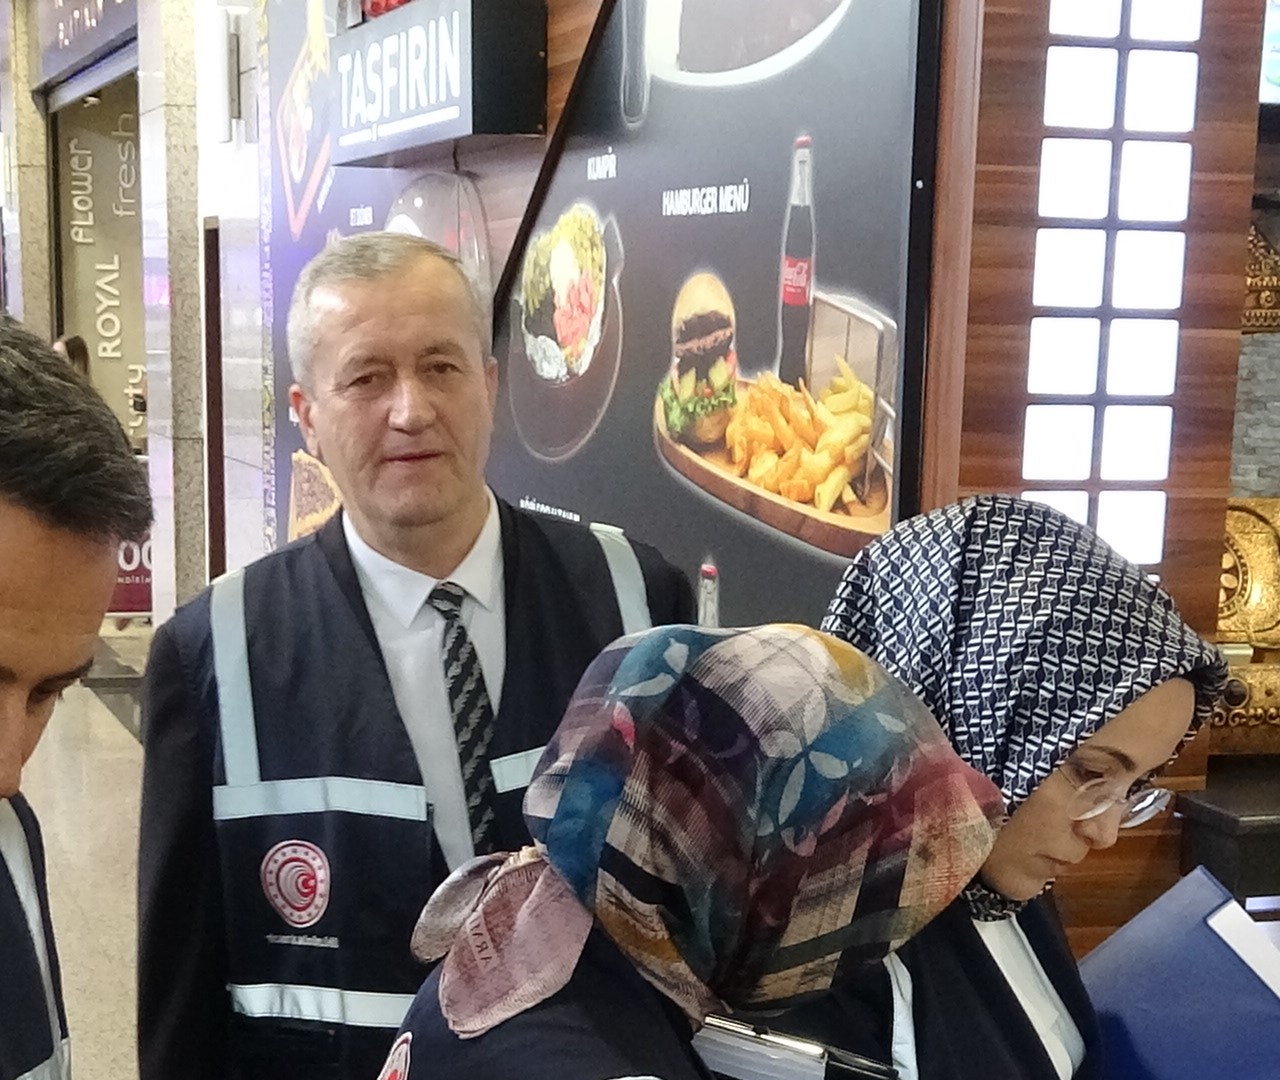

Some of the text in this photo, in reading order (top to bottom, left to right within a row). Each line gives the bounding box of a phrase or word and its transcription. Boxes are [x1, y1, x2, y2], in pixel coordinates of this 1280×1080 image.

[111, 112, 137, 217] fresh
[662, 177, 751, 217] HAMBURGER MENÜ
[94, 253, 122, 359] ROYAL
